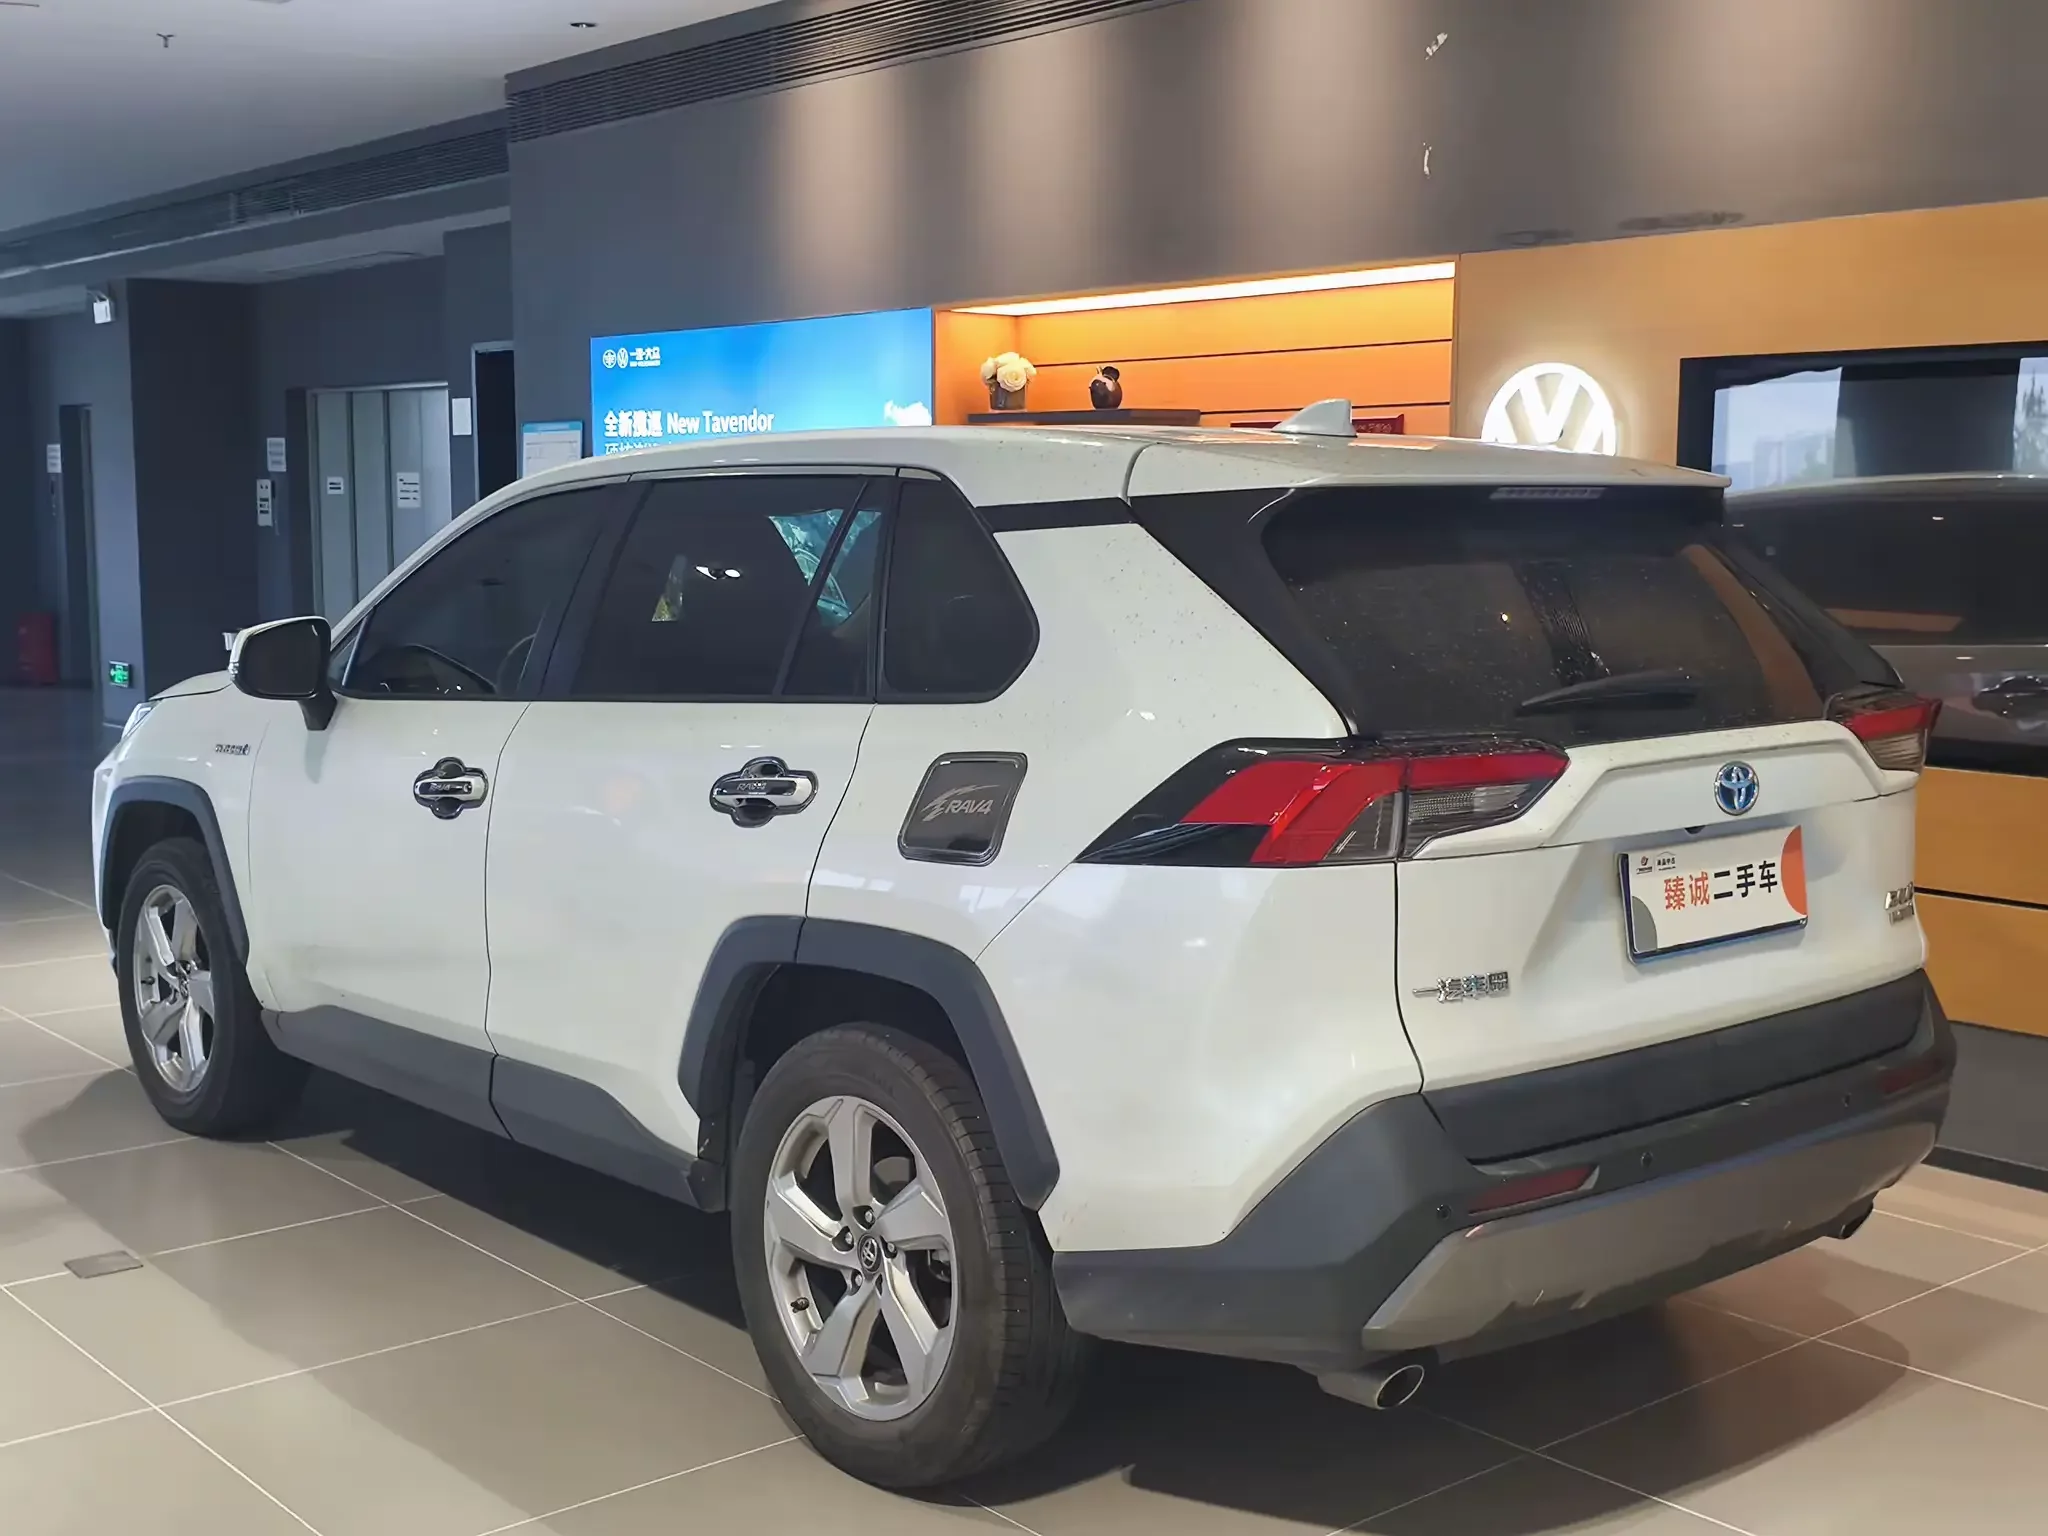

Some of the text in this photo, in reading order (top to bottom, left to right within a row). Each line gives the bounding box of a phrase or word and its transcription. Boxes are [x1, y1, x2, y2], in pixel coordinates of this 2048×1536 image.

[667, 411, 700, 435] New
[702, 408, 775, 433] Tavendor
[943, 800, 995, 815] RAV4
[1663, 860, 1778, 910] 臻诚二手车
